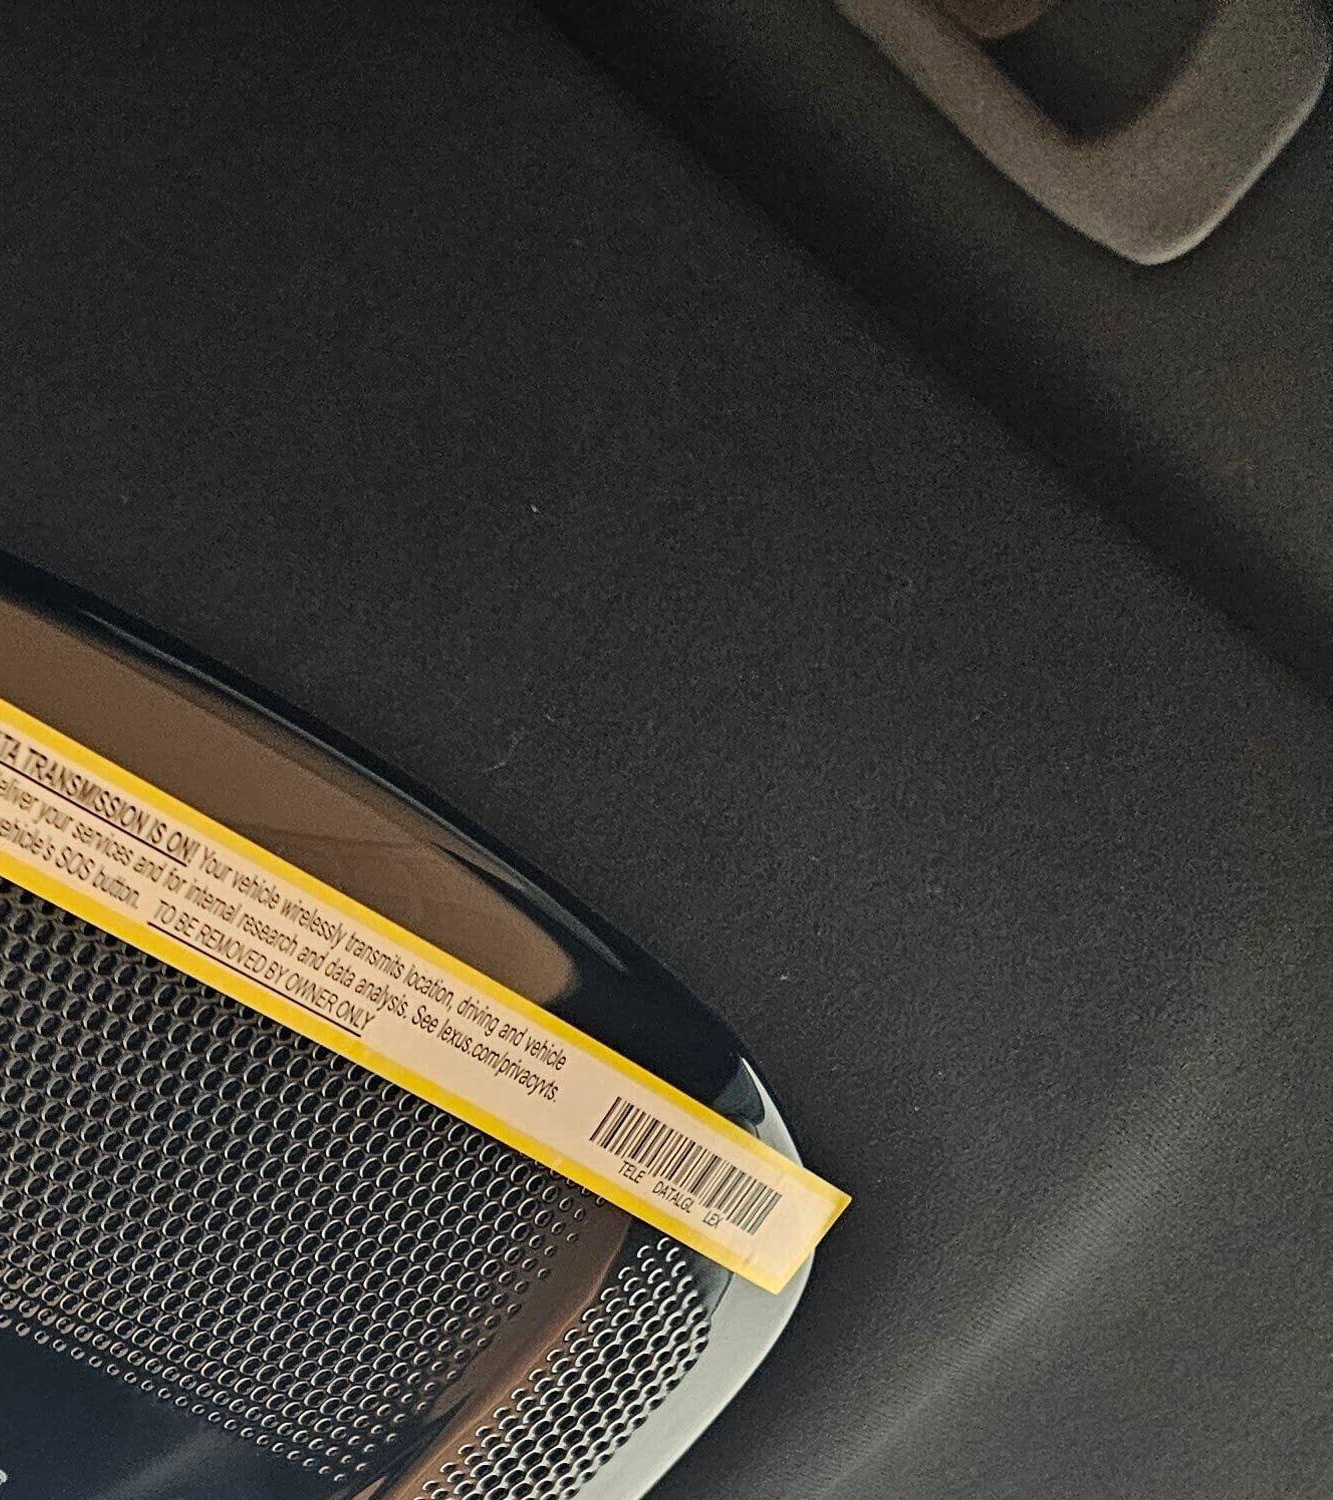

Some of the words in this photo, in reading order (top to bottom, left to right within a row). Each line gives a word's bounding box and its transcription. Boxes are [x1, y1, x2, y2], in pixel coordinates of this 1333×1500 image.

[19, 748, 150, 836] TRANSMISSION
[144, 819, 170, 847] IS
[164, 830, 201, 864] ON!
[194, 847, 236, 883] Your
[229, 866, 285, 911] vehicle
[275, 892, 350, 951] wirelessly
[343, 930, 410, 981] transmits
[399, 963, 462, 1012] location,
[452, 994, 503, 1038] driving
[496, 1017, 529, 1048] and
[521, 1032, 571, 1072] vehicle
[32, 801, 74, 839] your
[69, 815, 138, 868] services
[131, 850, 168, 884] and
[160, 866, 192, 897] for
[183, 878, 243, 925] internal
[236, 908, 302, 957] research
[295, 940, 329, 971] and
[322, 955, 360, 988] data
[350, 972, 416, 1024] analysis.
[409, 1003, 443, 1034] See
[433, 1018, 566, 1108] lexus.com/privacyvts.
[53, 845, 96, 882] SOS
[90, 866, 147, 910] button.
[151, 899, 177, 925] TO
[173, 911, 199, 937] BE
[194, 923, 269, 975] REMOVED
[263, 961, 287, 985] BY
[282, 970, 340, 1013] OWNER
[333, 998, 376, 1033] ONLY
[616, 1159, 646, 1184] TELE
[701, 1209, 725, 1229] LEX
